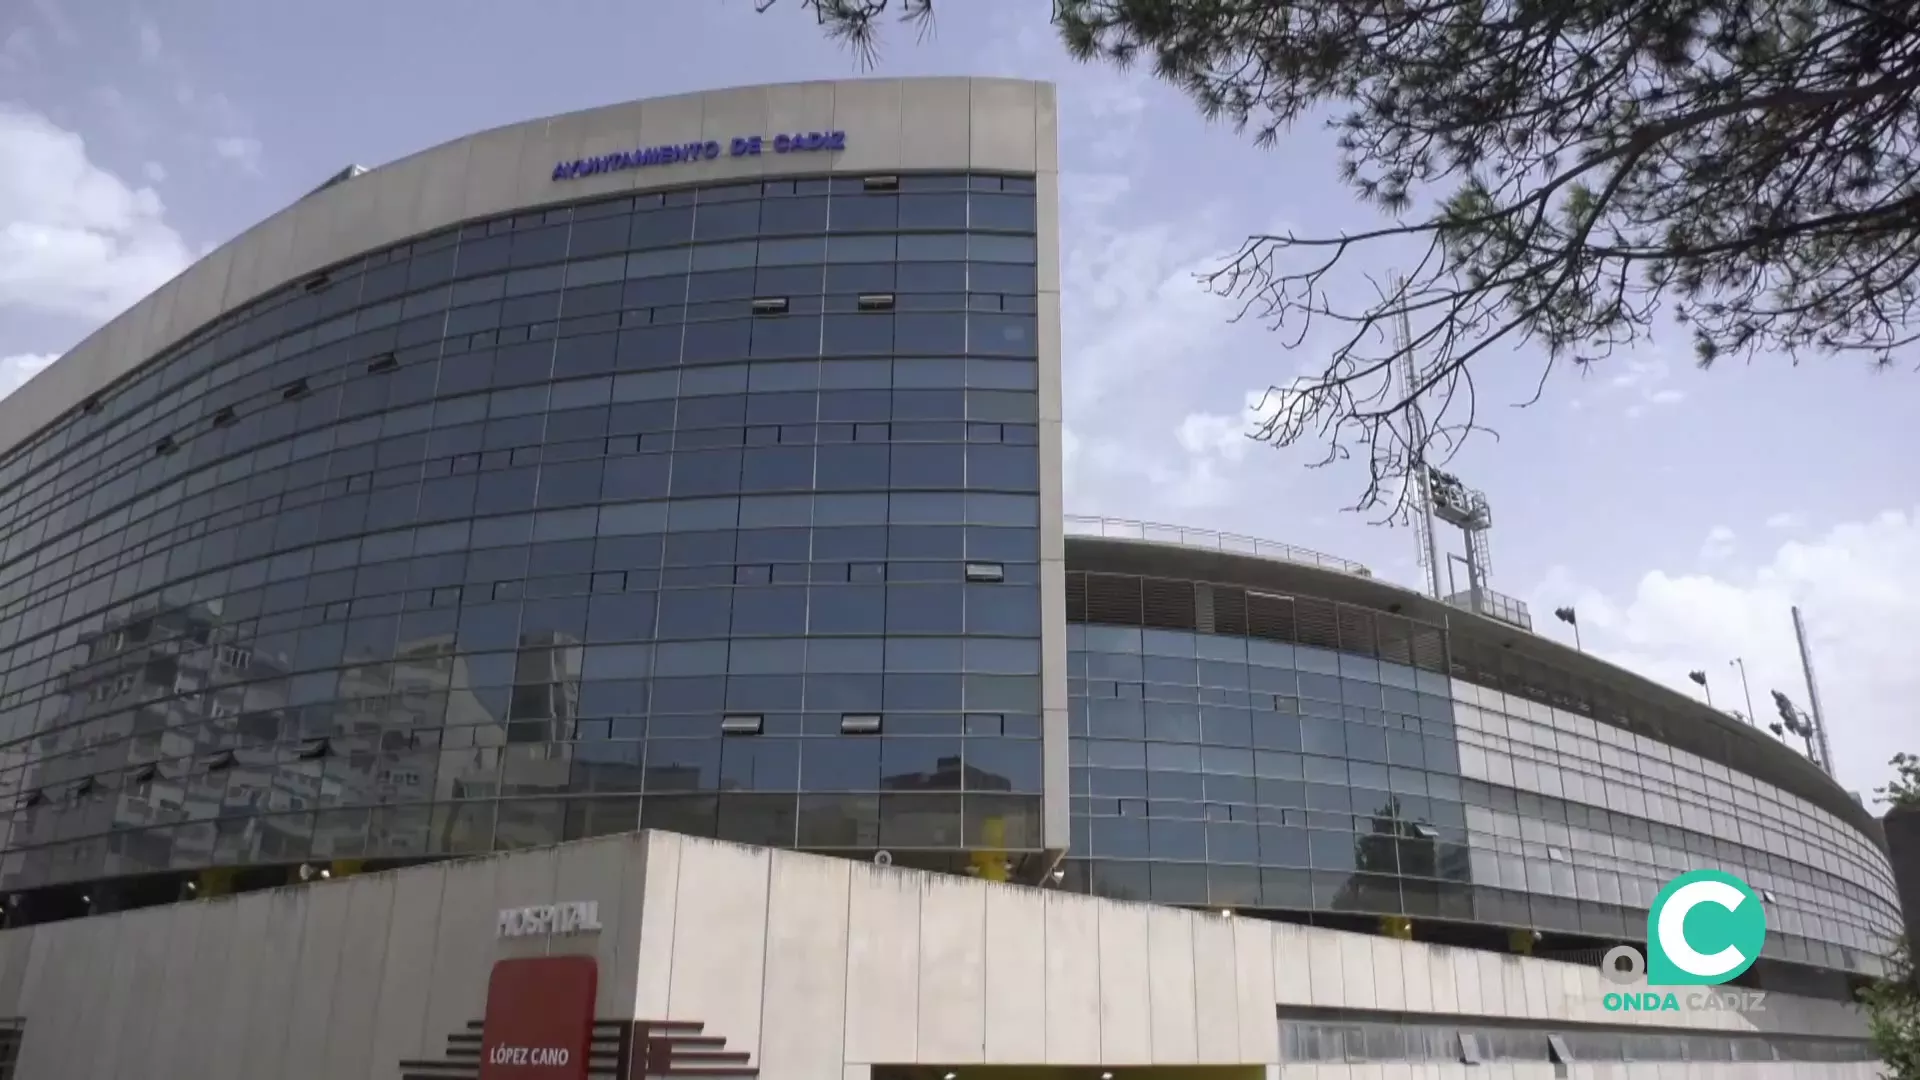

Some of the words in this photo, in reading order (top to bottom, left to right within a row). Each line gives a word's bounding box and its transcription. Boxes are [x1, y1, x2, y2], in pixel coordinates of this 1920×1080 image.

[552, 140, 720, 181] AYUNTAMIENTO
[730, 136, 762, 157] DE
[496, 901, 602, 937] HOSPITAL
[489, 1041, 529, 1065] LÓPEZ
[531, 1047, 570, 1066] CANO
